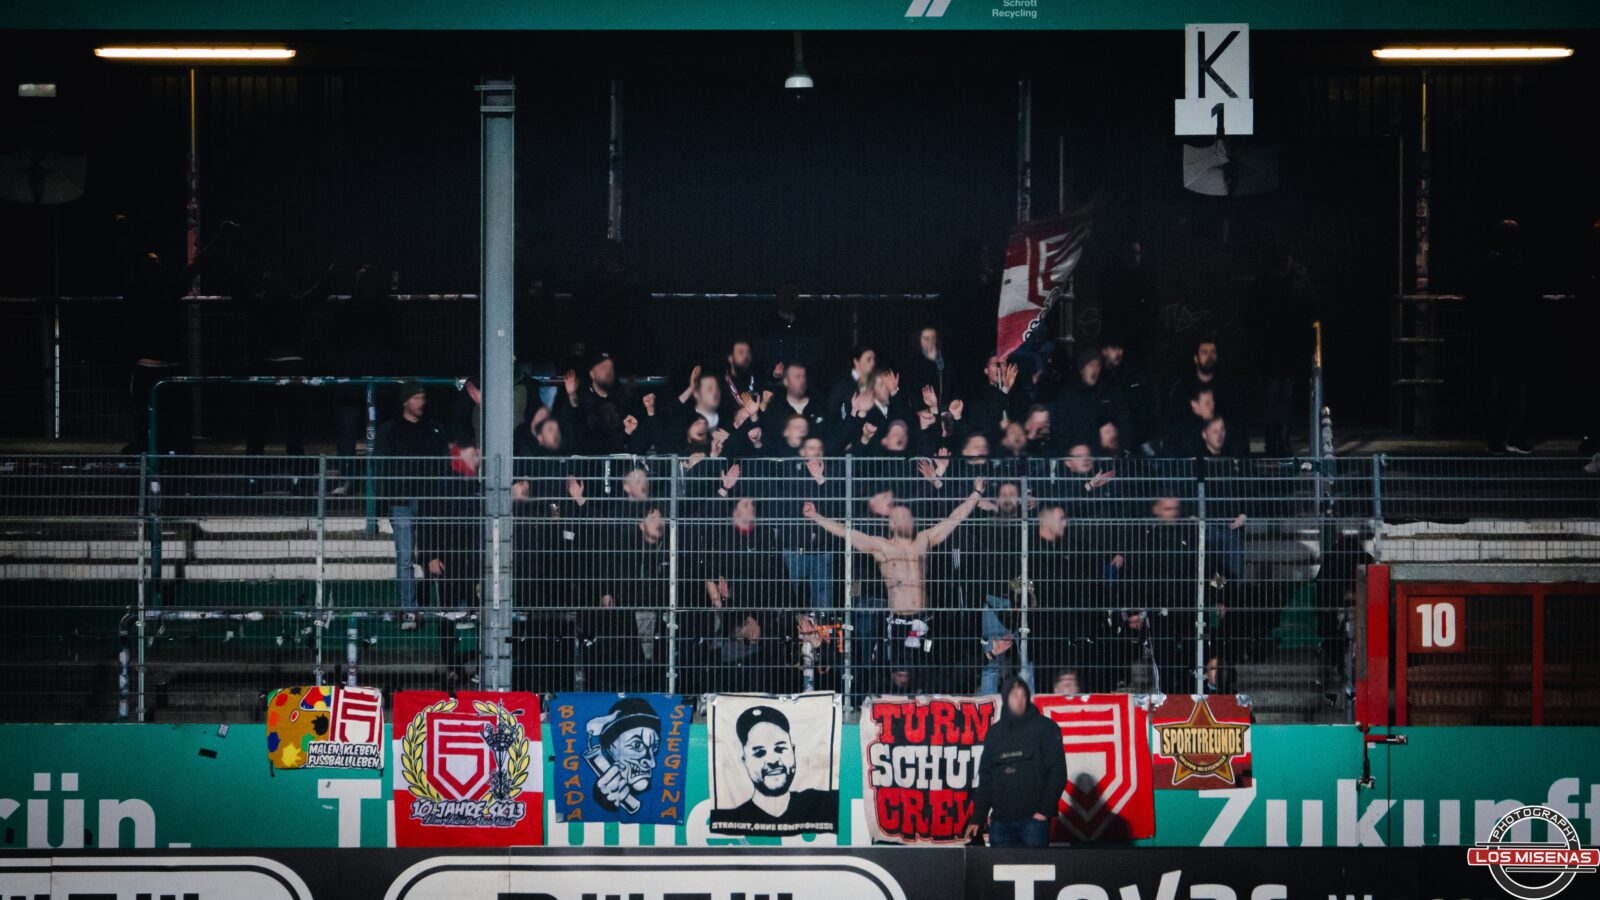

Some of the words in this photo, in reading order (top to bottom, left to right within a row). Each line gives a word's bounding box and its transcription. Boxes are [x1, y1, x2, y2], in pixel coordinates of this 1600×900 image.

[992, 9, 1037, 18] Recycling
[1197, 31, 1240, 98] K
[1416, 602, 1456, 647] 10
[873, 701, 993, 745] TURN
[1163, 728, 1241, 754] SPORTFREUNDE
[558, 705, 585, 820] BRIGADA
[661, 705, 686, 819] SIEGENA
[412, 801, 434, 818] 10
[435, 801, 485, 818] JAHRE
